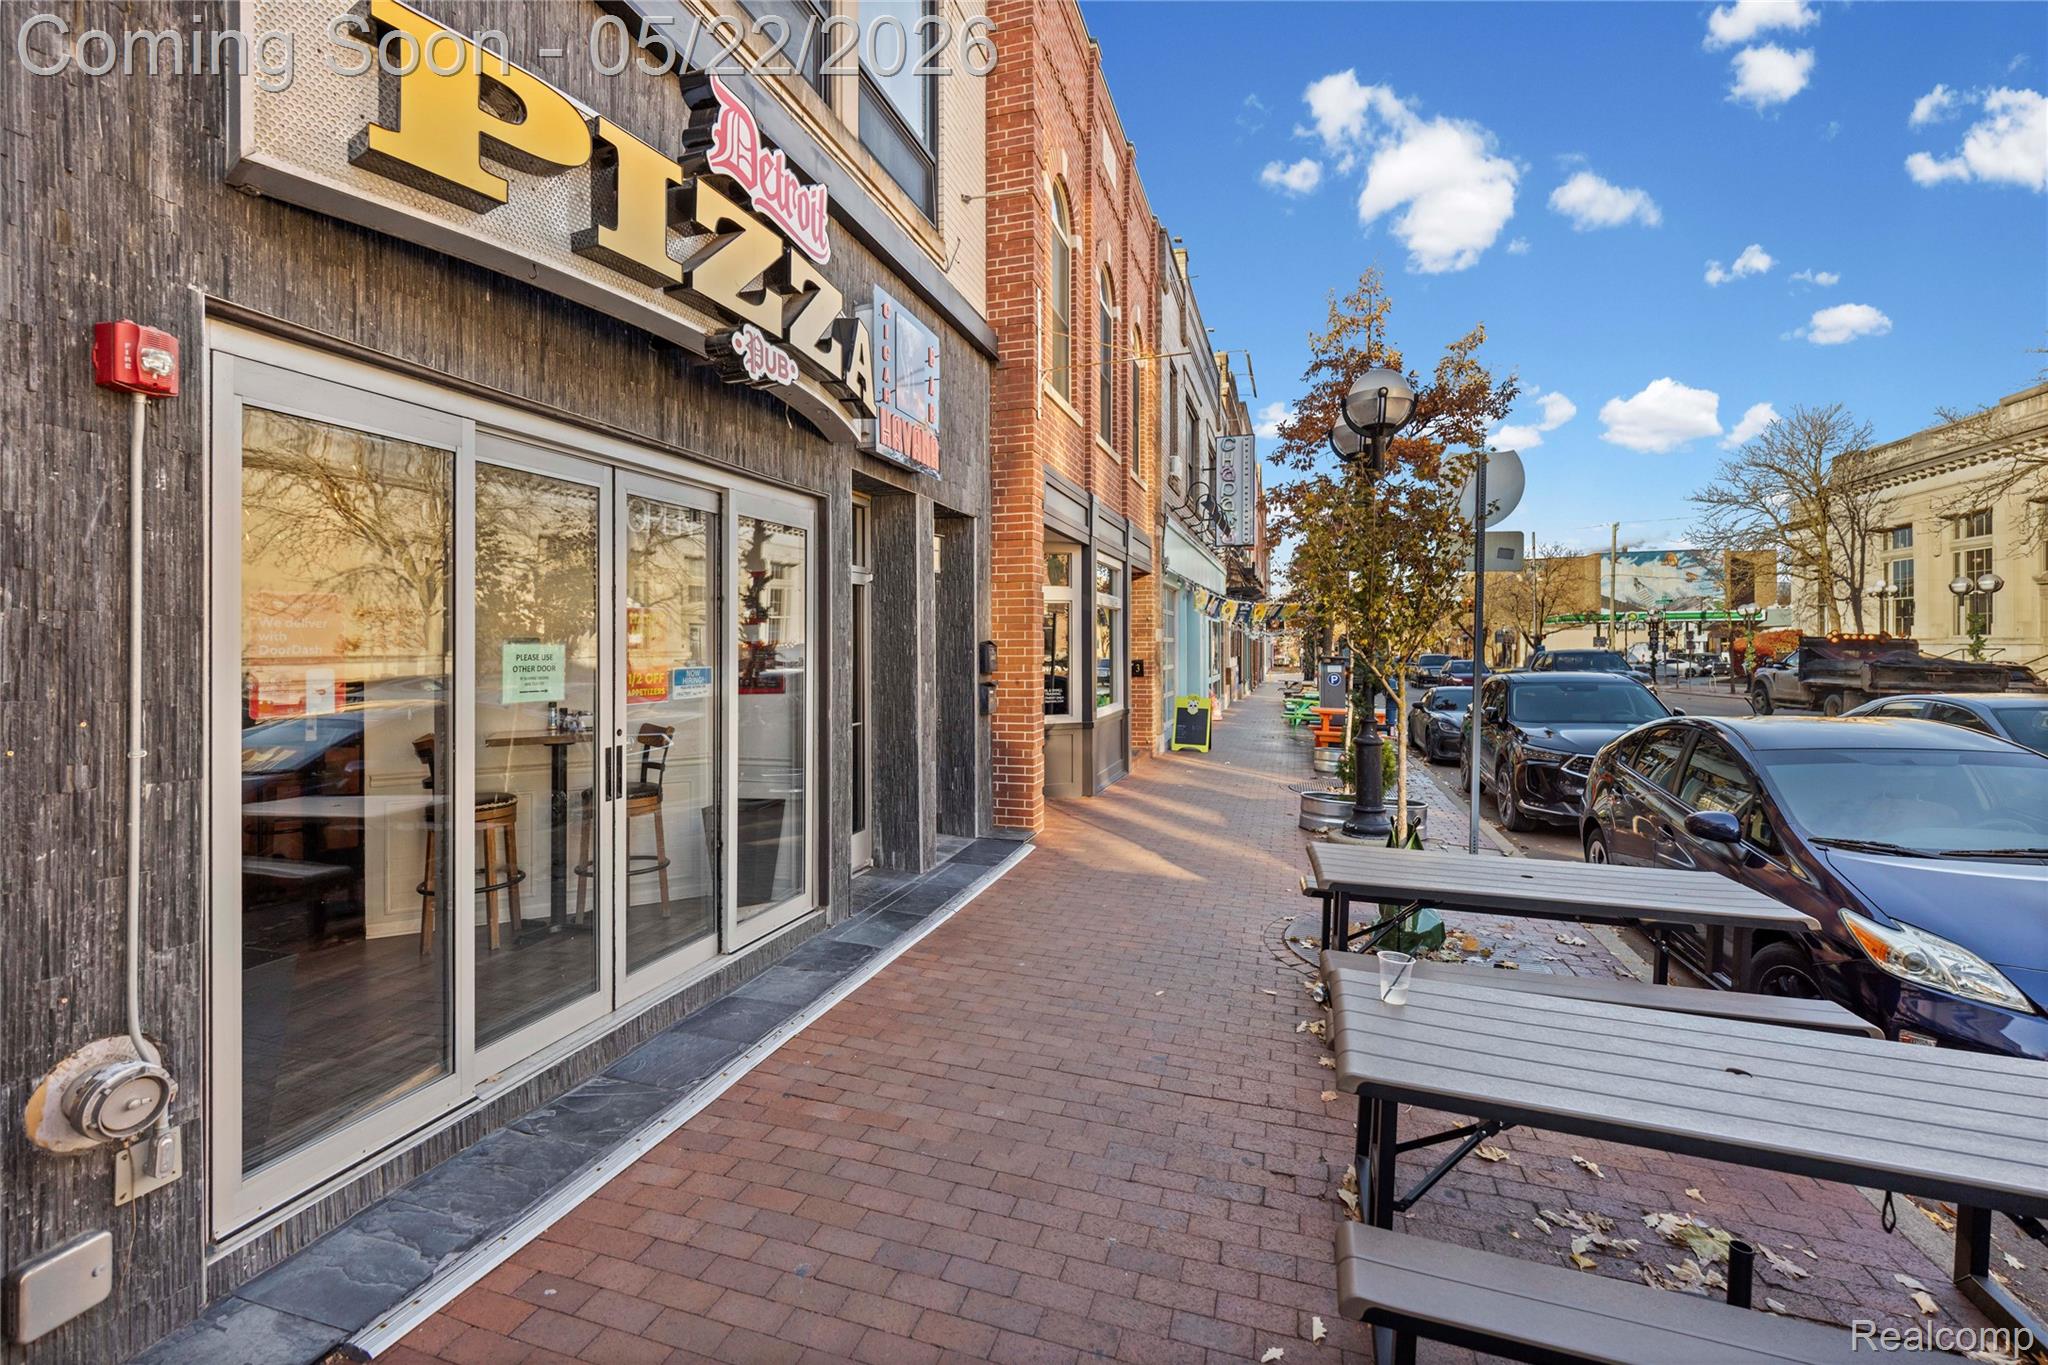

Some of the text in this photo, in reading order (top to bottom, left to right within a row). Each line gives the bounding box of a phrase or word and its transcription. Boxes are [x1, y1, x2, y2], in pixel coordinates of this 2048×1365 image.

[710, 73, 829, 258] Detroit
[368, 0, 877, 418] PIZZA
[257, 631, 288, 641] with
[258, 644, 321, 656] DoorDash
[516, 653, 553, 661] PLEASE USE
[512, 664, 556, 673] OTHER DOOR
[645, 672, 665, 684] OFF
[628, 687, 666, 697] APPETIZERS
